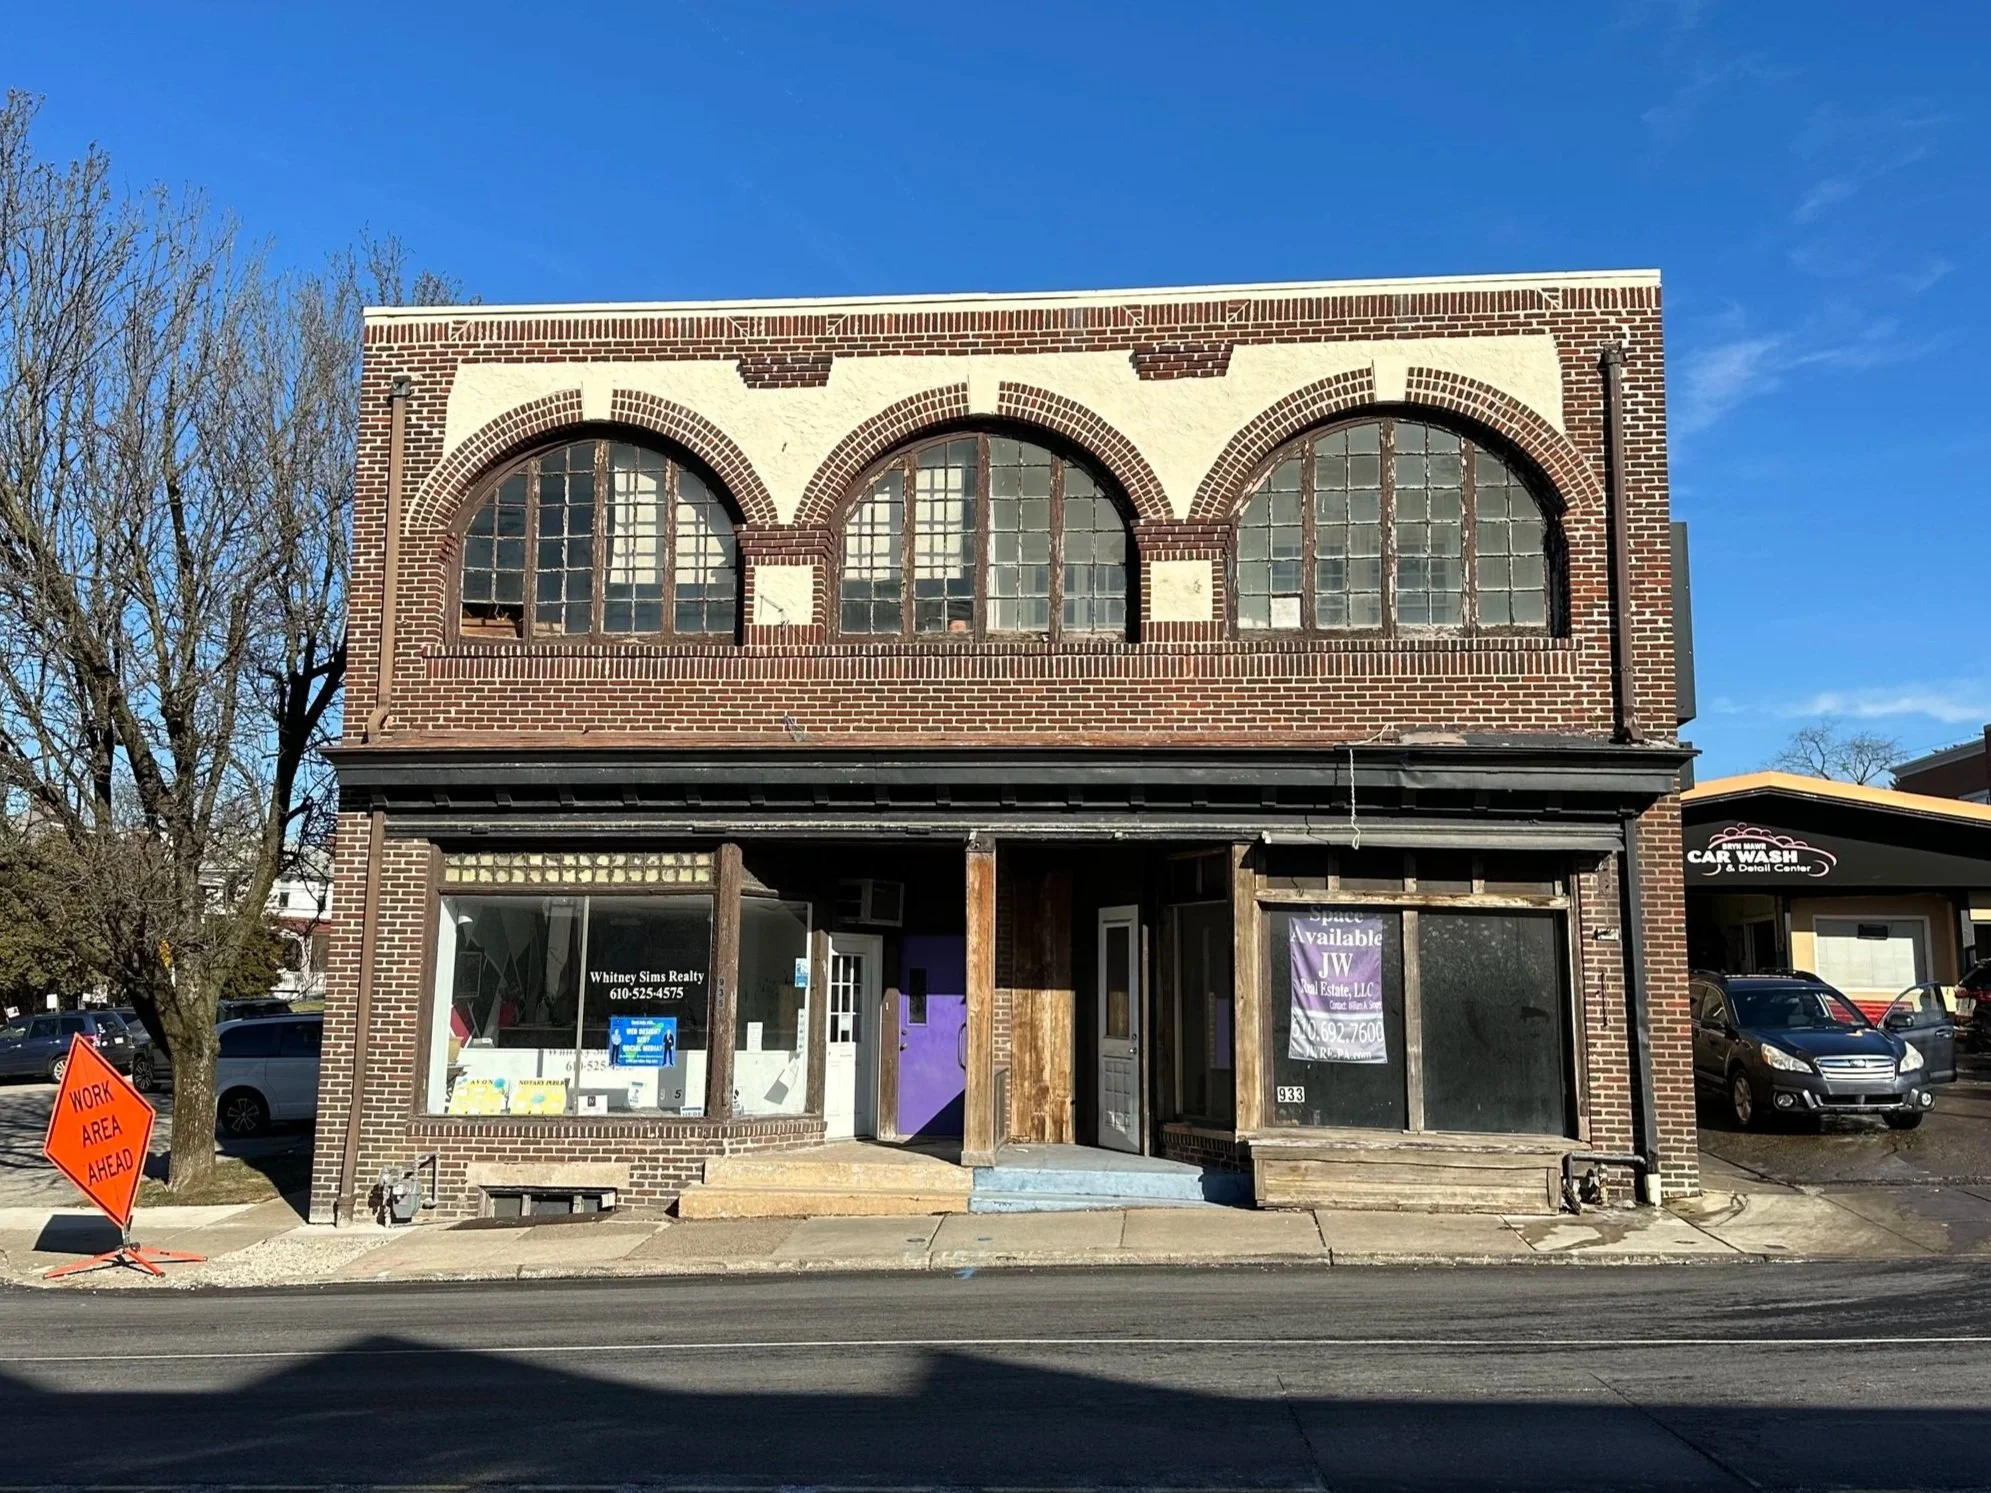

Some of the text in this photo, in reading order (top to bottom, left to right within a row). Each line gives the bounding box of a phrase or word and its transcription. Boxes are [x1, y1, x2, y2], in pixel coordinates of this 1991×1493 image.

[1687, 850, 1798, 863] CAR WASH
[1726, 864, 1811, 873] & Detail Center
[1309, 905, 1364, 926] Space
[1290, 925, 1382, 947] Available
[1318, 952, 1354, 979] JW
[590, 970, 705, 986] Whitney Sims Realty
[1300, 978, 1374, 999] Real Estate, LLC
[69, 1080, 115, 1113] WORK
[1278, 1087, 1304, 1102] 933
[82, 1114, 123, 1148] AREA
[88, 1149, 134, 1186] AHEAD
